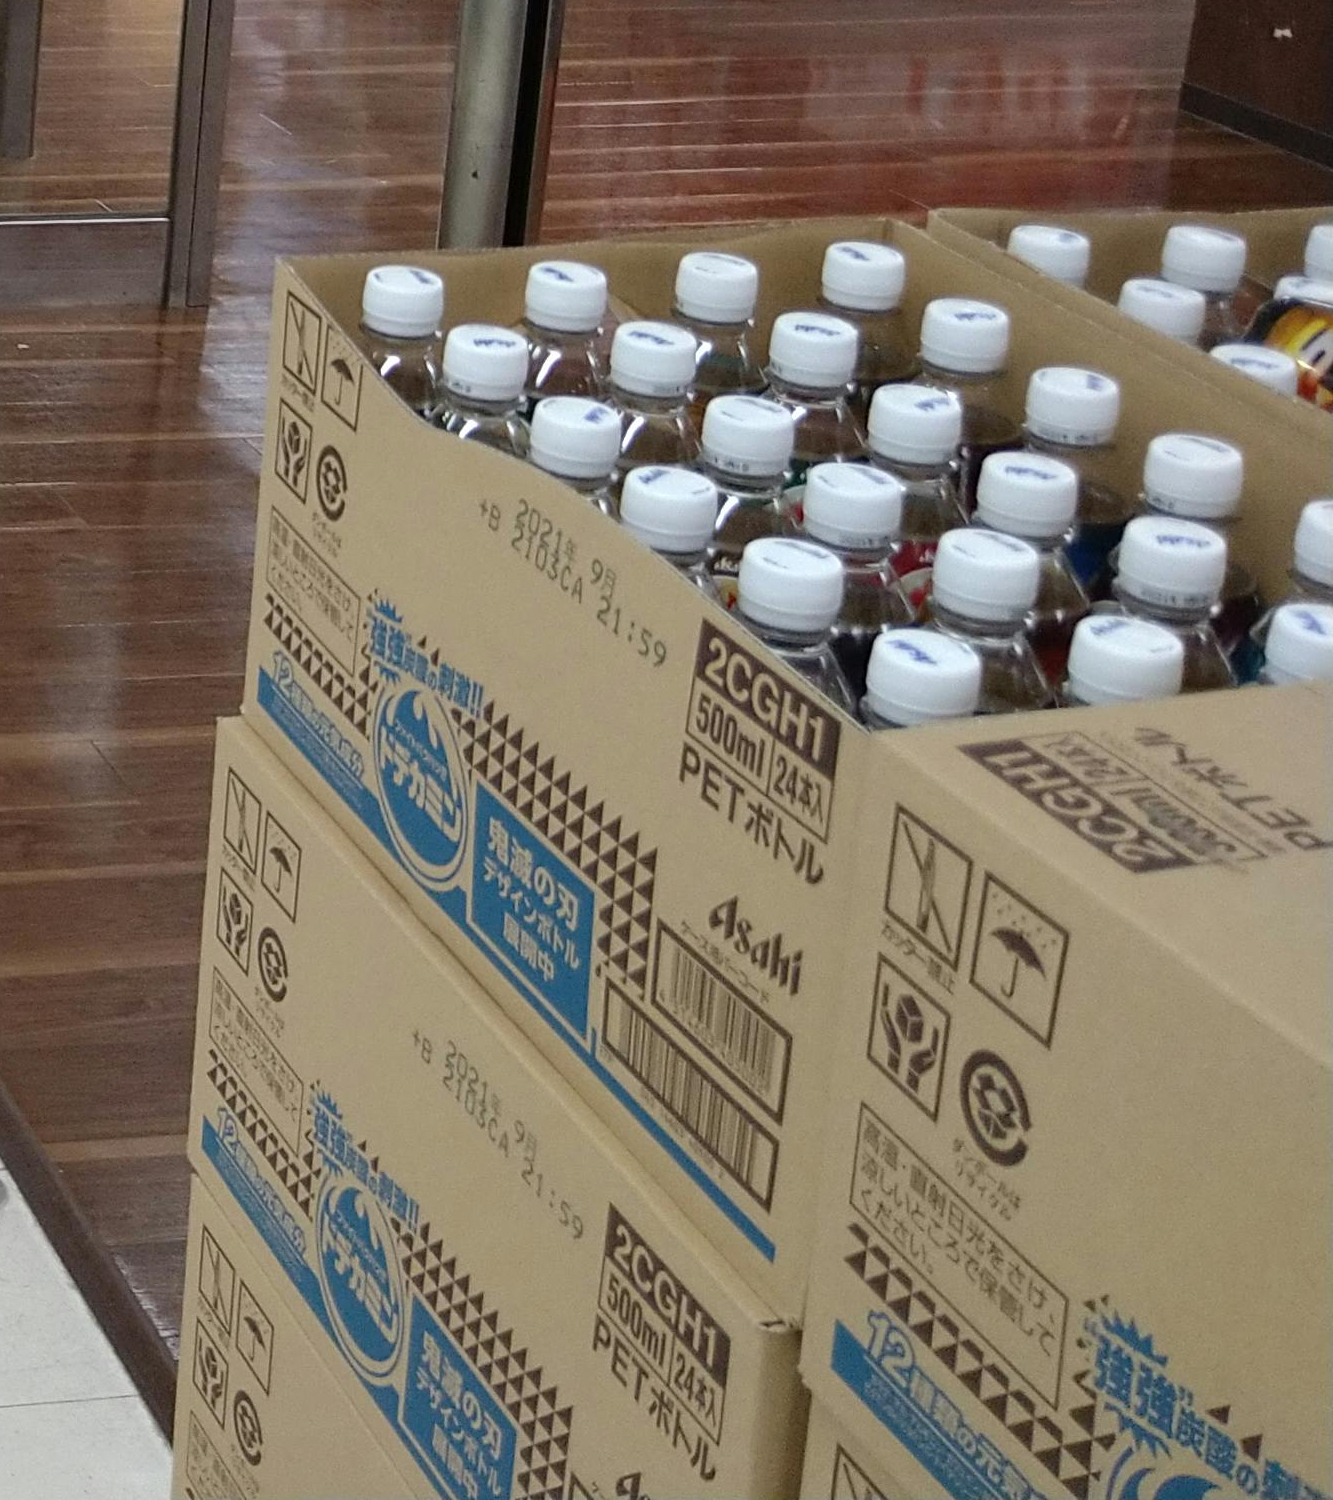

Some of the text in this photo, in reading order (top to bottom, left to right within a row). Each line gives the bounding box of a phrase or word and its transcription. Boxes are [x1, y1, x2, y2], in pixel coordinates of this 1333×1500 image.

[596, 595, 667, 668] 21:59
[695, 694, 766, 779] 500ml
[704, 636, 825, 762] 2CGH1
[679, 741, 825, 886] PETボトル
[708, 894, 804, 997] Asahi
[521, 1156, 583, 1240] 21:59
[607, 1272, 668, 1368] 500ml
[616, 1223, 716, 1368] 2CGH1
[592, 1311, 717, 1483] PETボトル
